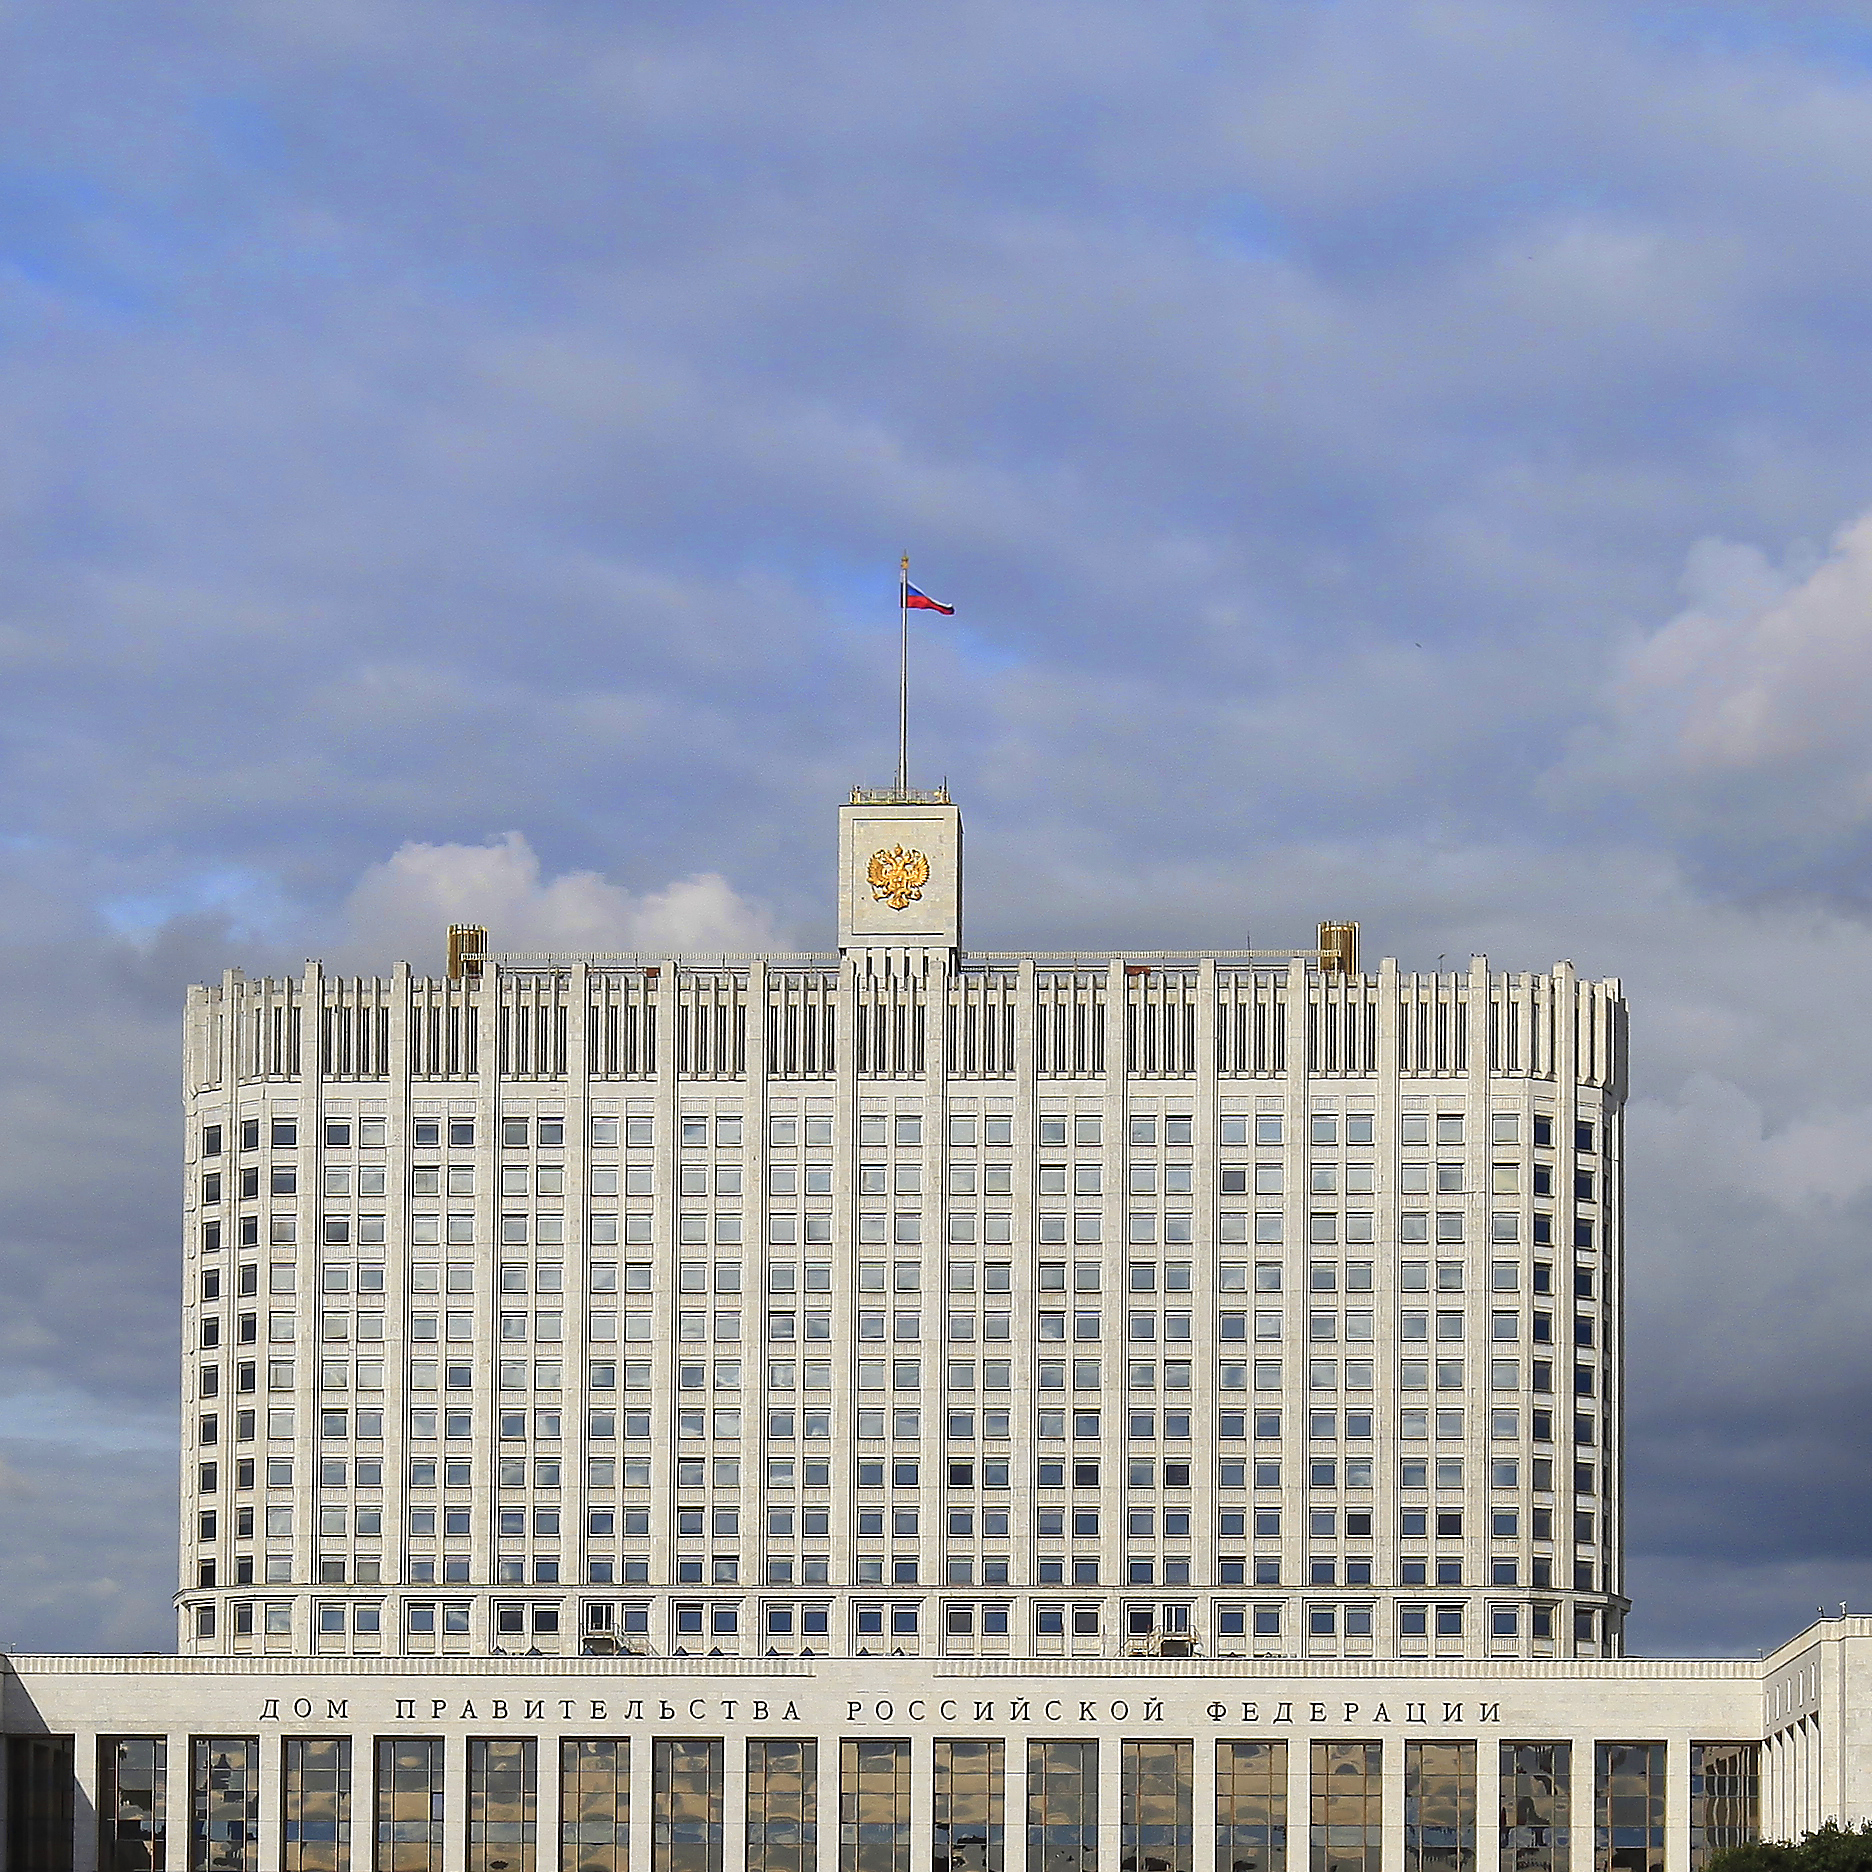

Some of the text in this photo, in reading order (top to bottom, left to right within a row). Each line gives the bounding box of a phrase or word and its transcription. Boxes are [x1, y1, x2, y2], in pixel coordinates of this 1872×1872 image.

[259, 1696, 1502, 1724] ДОМ ПРАВИТЕЛЬСТВА РОССИЙСКОЙ ФЕДЕРАЦИИ
